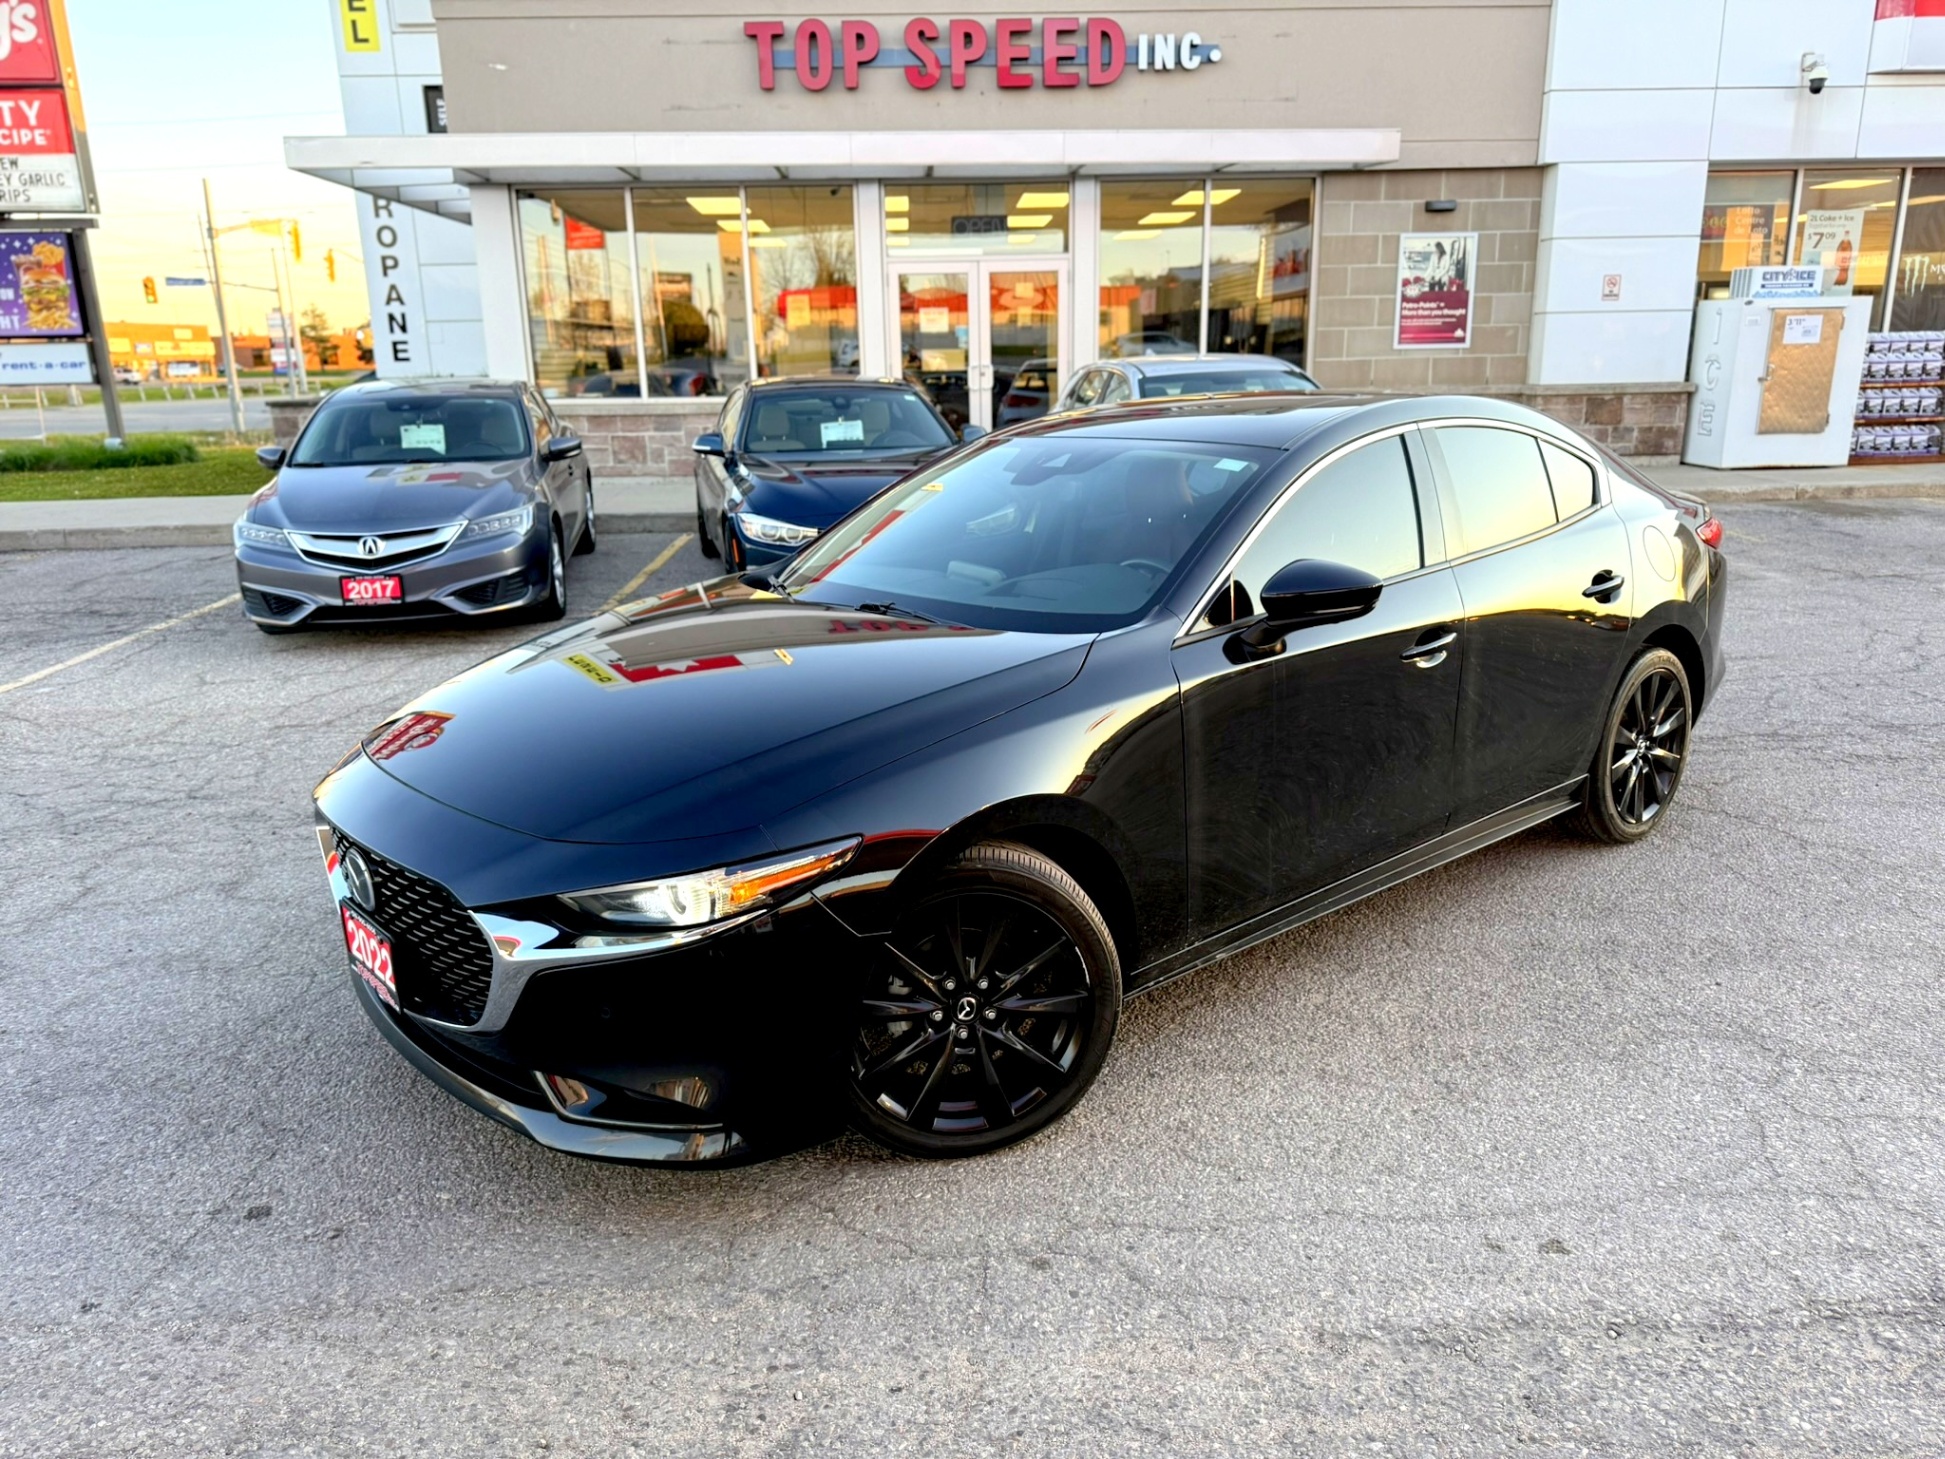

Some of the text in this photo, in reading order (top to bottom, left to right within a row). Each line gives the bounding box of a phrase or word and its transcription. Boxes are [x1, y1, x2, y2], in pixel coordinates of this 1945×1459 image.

[744, 18, 880, 90] TOP
[903, 17, 1127, 89] SPEED
[1819, 214, 1836, 222] Coke
[1762, 270, 1816, 281] CITY ICE
[347, 580, 395, 599] 2017
[347, 919, 397, 993] 2022
